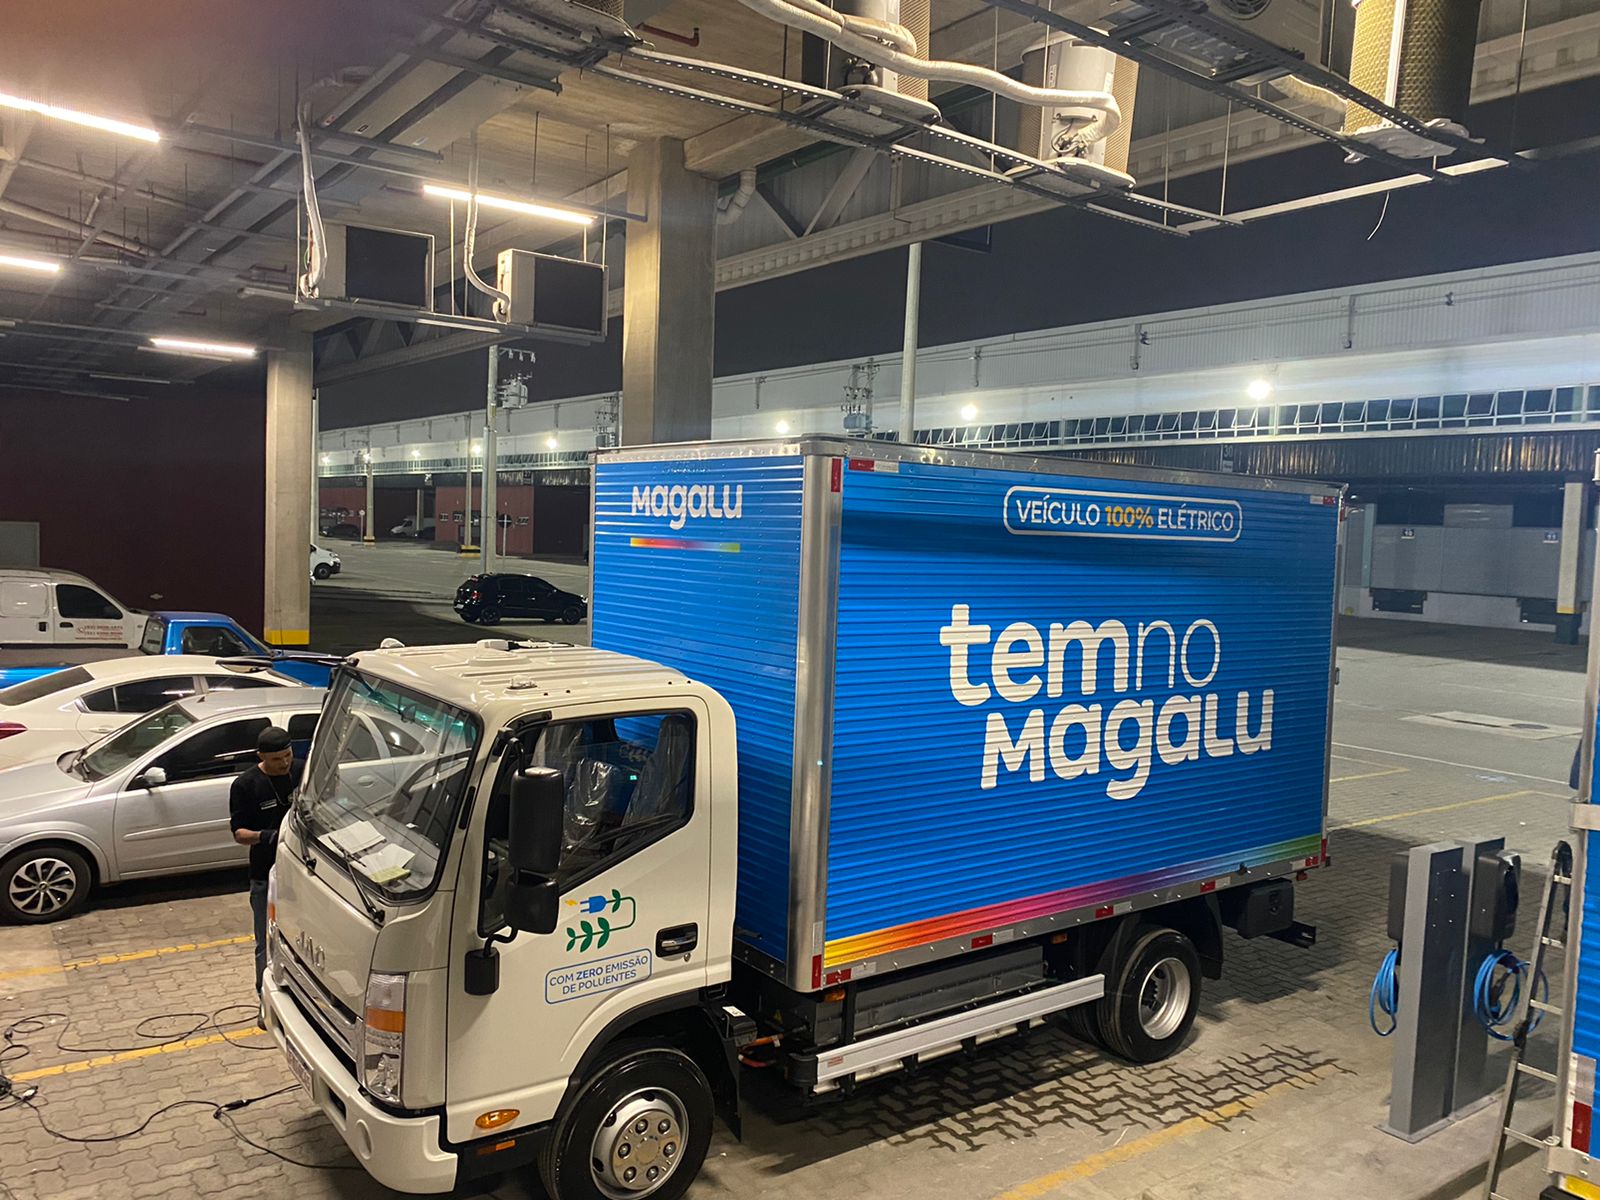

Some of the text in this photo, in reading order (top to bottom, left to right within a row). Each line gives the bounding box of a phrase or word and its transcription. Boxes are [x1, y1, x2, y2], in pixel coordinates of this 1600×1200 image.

[1016, 495, 1234, 532] VEÍCULO 100% ELÉTRICO
[549, 955, 648, 986] COM ZERO EMISSÃO
[562, 969, 637, 994] DE POLUENTES
